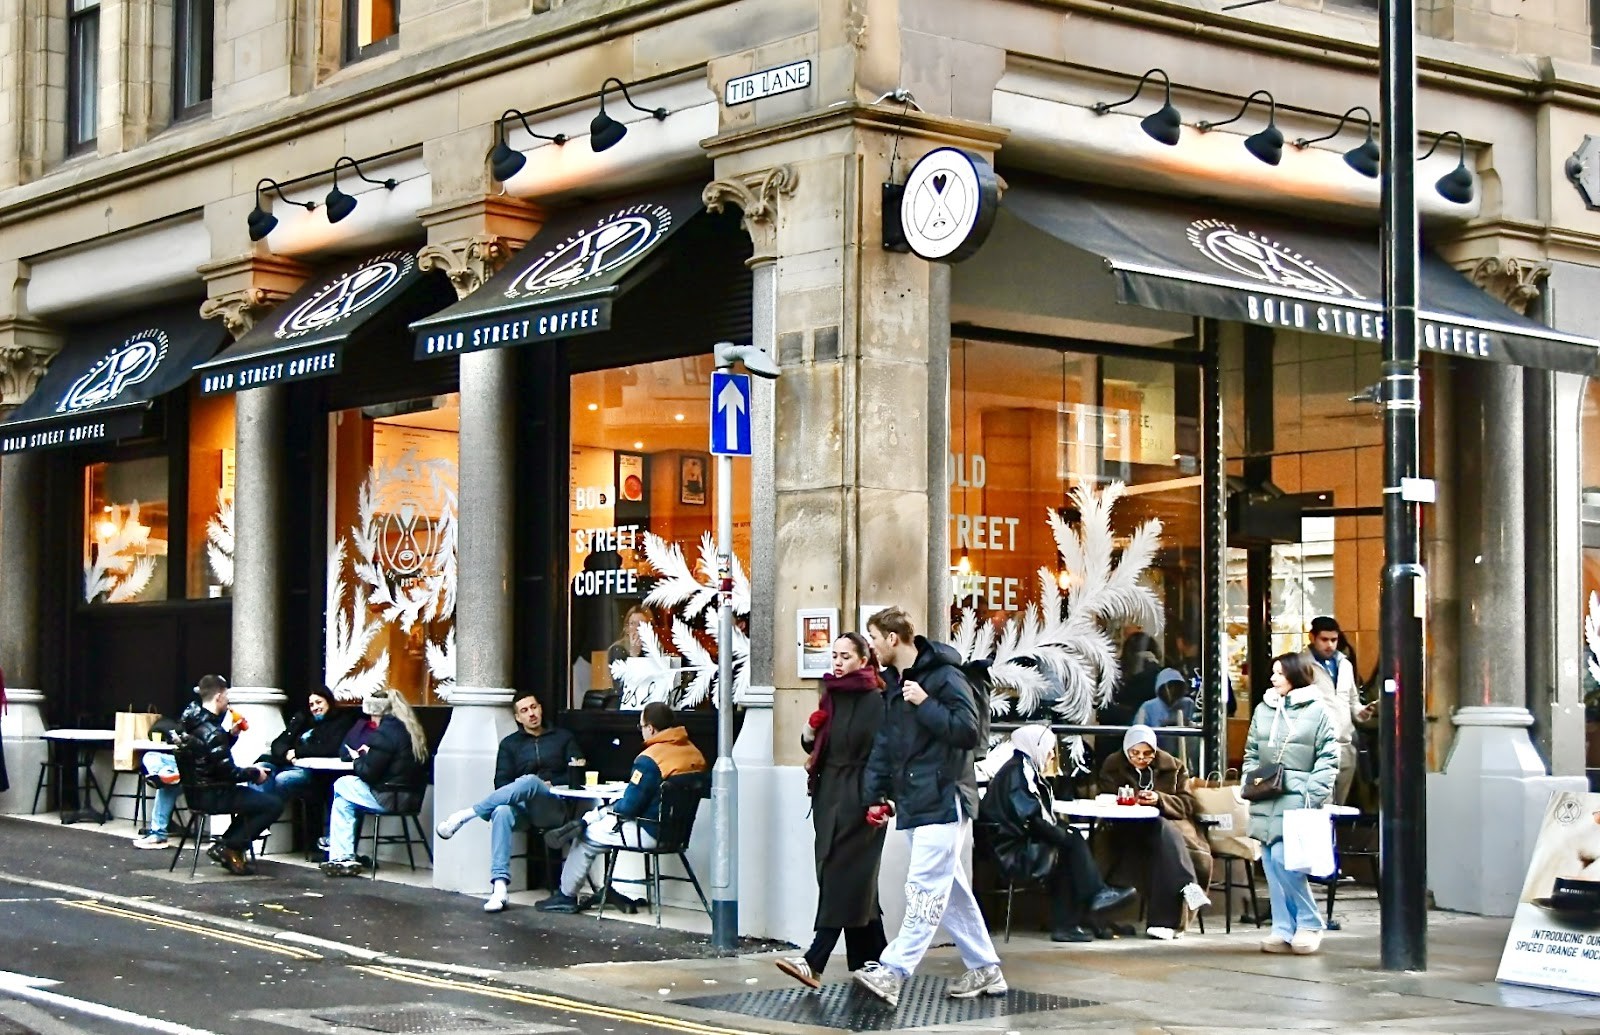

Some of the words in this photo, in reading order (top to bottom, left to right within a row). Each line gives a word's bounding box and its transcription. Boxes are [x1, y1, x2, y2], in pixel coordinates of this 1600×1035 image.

[731, 80, 754, 100] TIB
[762, 67, 806, 93] LANE
[427, 331, 464, 354] BOLD
[473, 320, 530, 347] STREET
[539, 308, 599, 335] COFFEE
[1247, 295, 1305, 328] BOLD
[1317, 306, 1385, 340] STREE
[1424, 324, 1490, 357] OFFEE
[204, 373, 234, 393] BOLD
[239, 363, 284, 386] STREET
[289, 353, 336, 376] COFFEE
[3, 436, 27, 451] BOLD
[30, 428, 65, 447] STREET
[69, 423, 105, 441] COFFEE
[947, 453, 986, 488] OLD
[575, 524, 639, 554] STREET
[947, 513, 1020, 551] REET
[574, 568, 638, 597] COFFEE
[951, 576, 1019, 612] FFEE
[1515, 940, 1544, 953] SPICED
[1545, 944, 1578, 957] ORANGE
[1531, 929, 1584, 944] INTRODUCING
[1585, 935, 1600, 947] OUR
